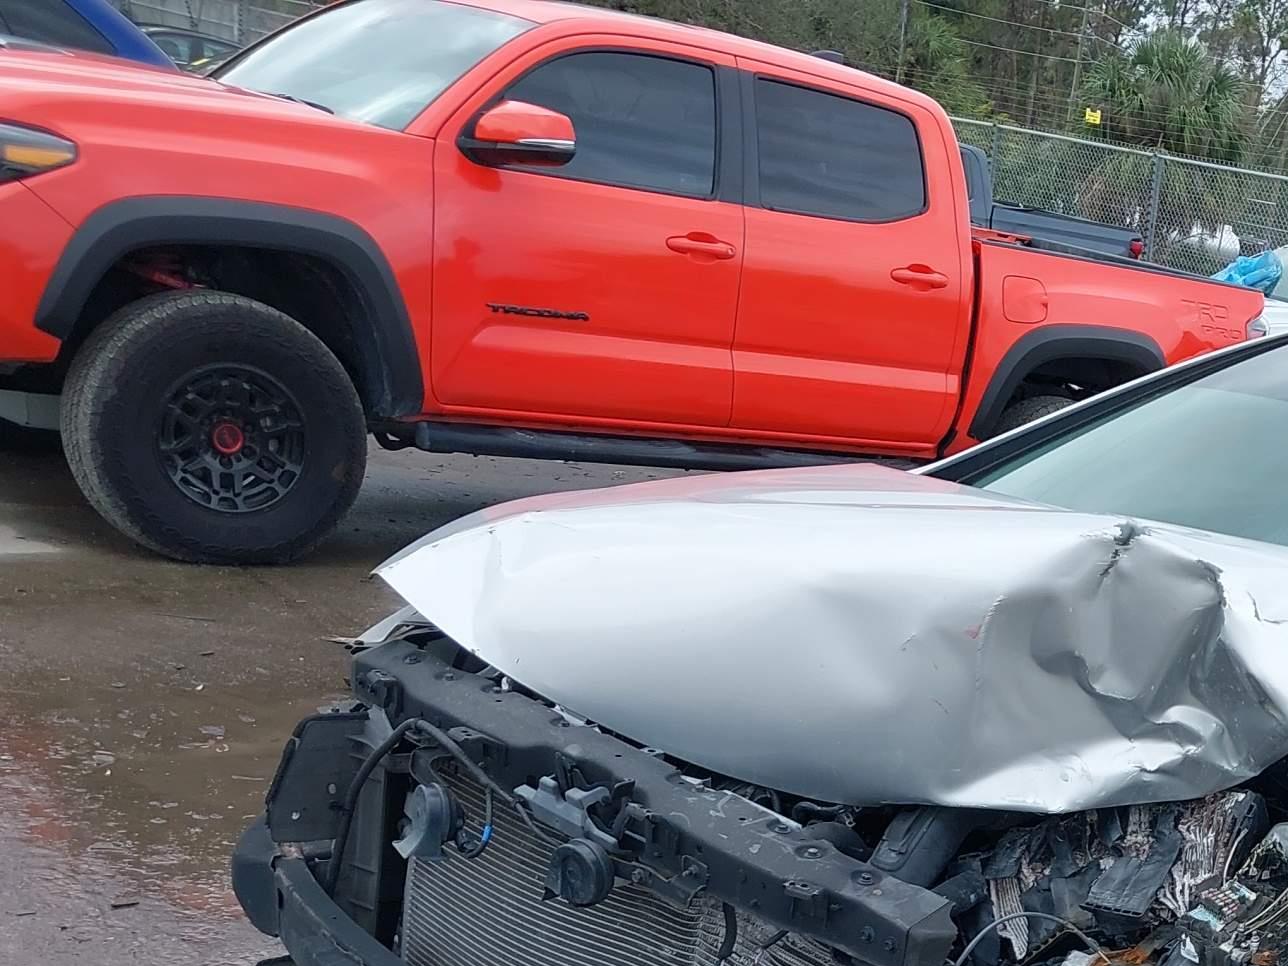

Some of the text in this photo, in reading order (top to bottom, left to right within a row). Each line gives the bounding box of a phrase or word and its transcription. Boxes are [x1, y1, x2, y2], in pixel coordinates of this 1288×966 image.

[485, 303, 590, 321] TACOMA
[1181, 299, 1229, 323] TRD
[1201, 324, 1242, 340] PRO
